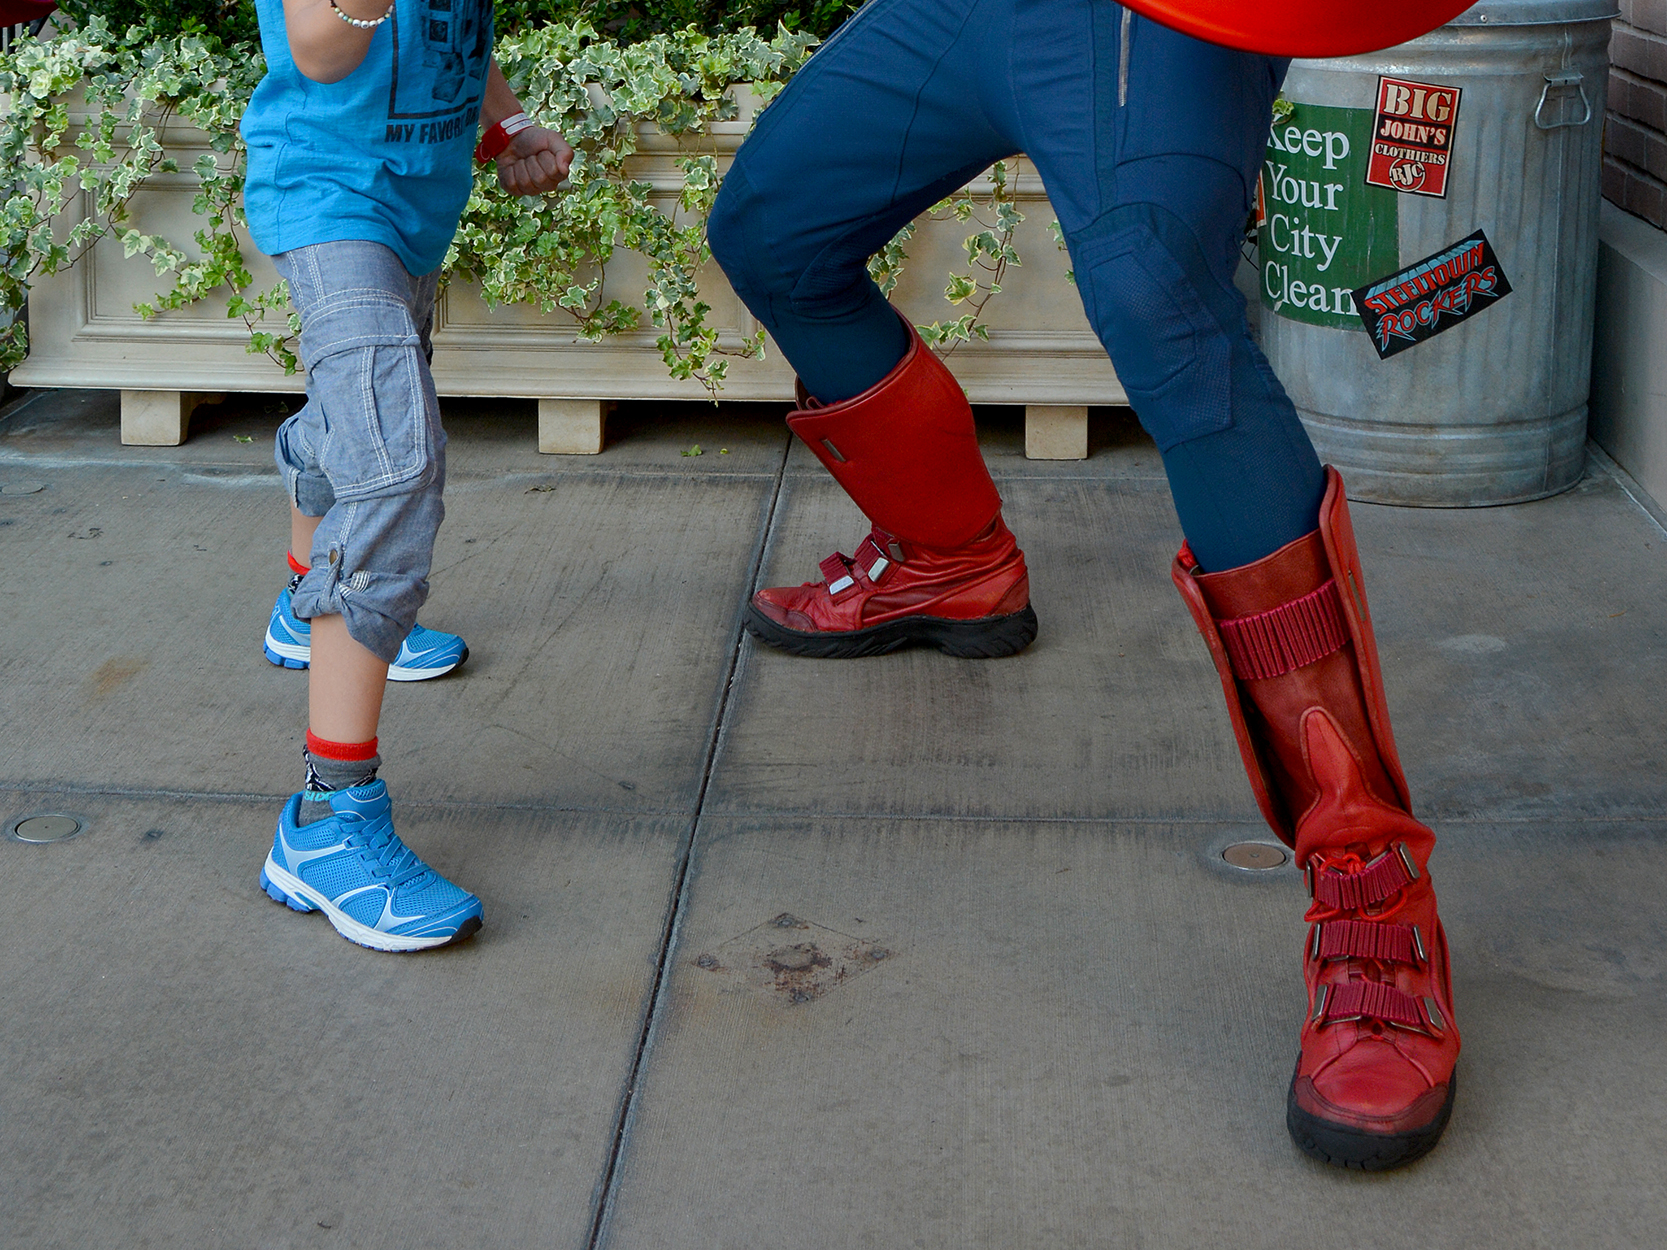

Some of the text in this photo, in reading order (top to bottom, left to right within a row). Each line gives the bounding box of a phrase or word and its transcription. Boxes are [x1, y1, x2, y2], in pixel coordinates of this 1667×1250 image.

[1383, 83, 1451, 122] BIG
[384, 124, 415, 143] MY
[1374, 143, 1446, 166] CLOTHIERS
[1379, 119, 1447, 146] JOHN'S
[1265, 160, 1344, 210] Your
[1270, 214, 1343, 271] City
[1265, 261, 1360, 316] Clean
[1364, 239, 1485, 317] STEELTOWN
[1376, 265, 1499, 352] ROCKERS
